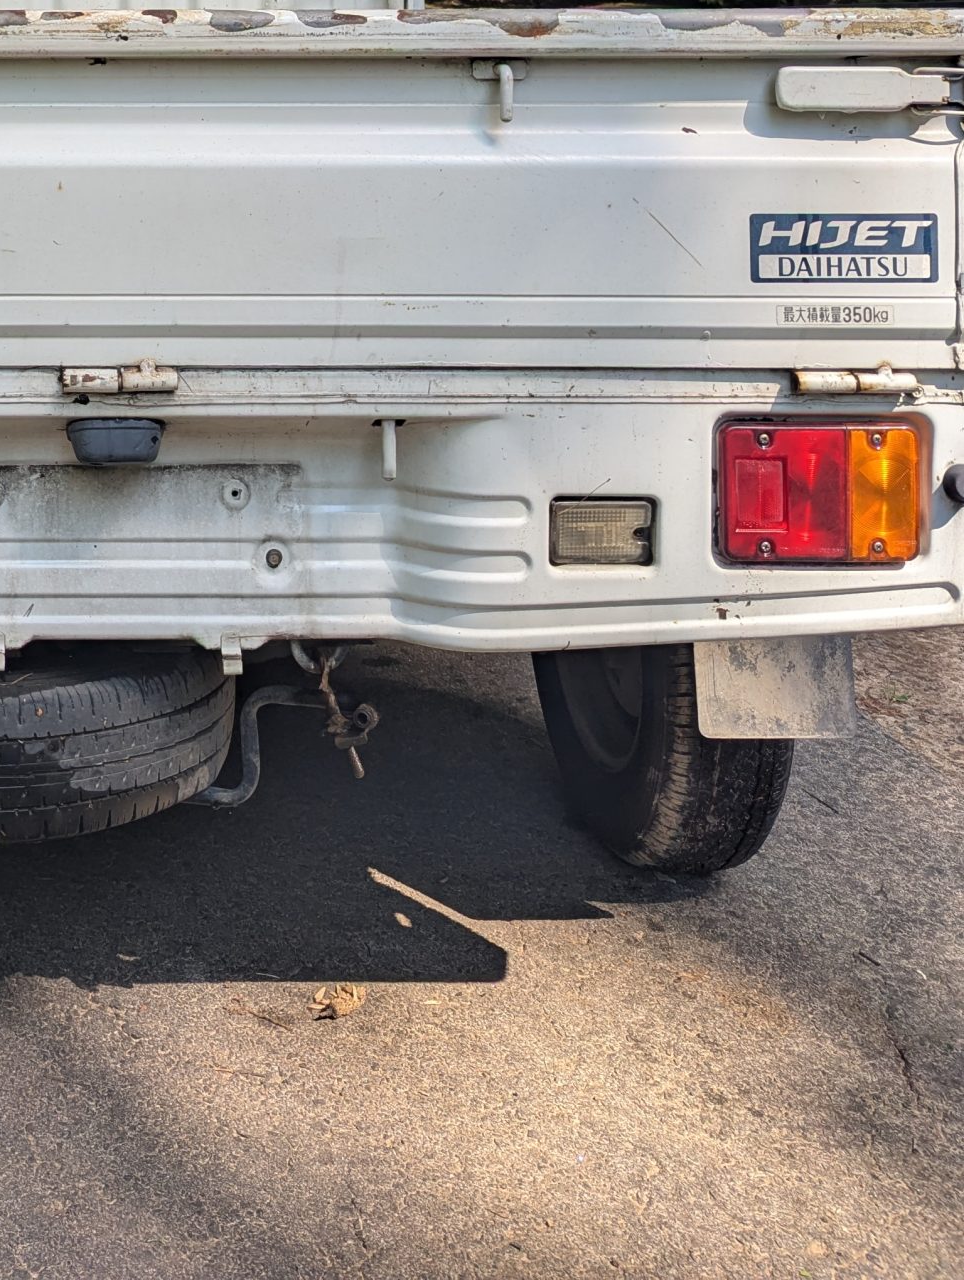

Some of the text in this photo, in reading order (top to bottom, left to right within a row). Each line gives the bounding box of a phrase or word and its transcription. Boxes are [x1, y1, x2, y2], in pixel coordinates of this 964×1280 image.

[759, 220, 933, 249] HIJET
[778, 257, 908, 277] DAIHATSU
[783, 306, 889, 323] 最大積載量350kg
